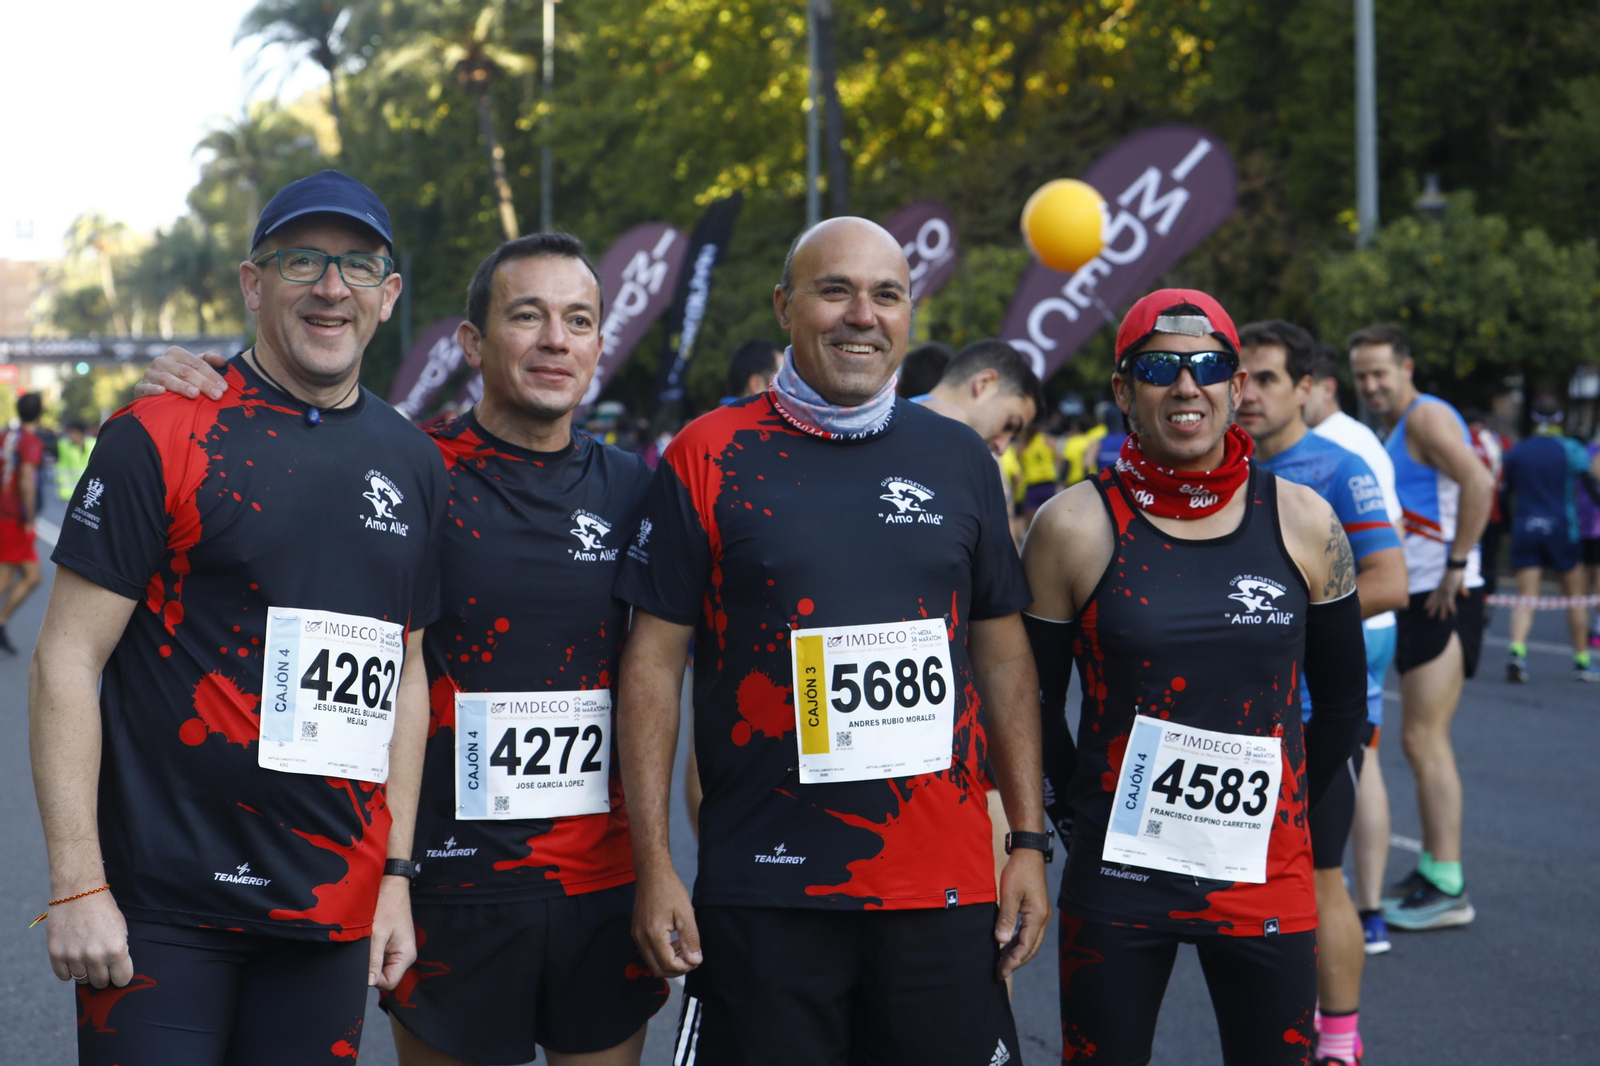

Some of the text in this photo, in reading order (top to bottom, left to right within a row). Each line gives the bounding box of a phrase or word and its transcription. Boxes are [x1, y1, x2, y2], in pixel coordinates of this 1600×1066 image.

[365, 469, 375, 481] CLUB
[381, 475, 404, 499] ATLETISMO
[881, 476, 893, 487] CLUB
[903, 479, 935, 496] ATLETISMO
[571, 508, 581, 520] CLUB
[586, 512, 612, 528] ATLETISMO
[1229, 575, 1243, 586] CLUB
[1253, 575, 1287, 591] ATLETISMO
[324, 621, 378, 641] IMDECO
[846, 630, 907, 647] IMDECO
[911, 635, 918, 643] 36
[274, 649, 291, 713] CAJÓN 4
[300, 648, 396, 712] 4262
[831, 655, 947, 713] 5686
[804, 666, 819, 727] CAJÓN 3
[313, 703, 388, 721] JESÚS RAFAEL BUJALANCE
[510, 700, 570, 714] IMDECO
[346, 716, 368, 727] MEJÍAS
[848, 713, 936, 728] ANDRES RUBIO MORALES
[490, 724, 603, 776] 4272
[1183, 734, 1242, 755] IMDECO
[465, 743, 479, 790] CAJÓN
[516, 779, 585, 789] JOSÉ GARCÍA LÓPEZ
[1125, 752, 1148, 810] CAJÓN 4
[1151, 758, 1270, 816] 4583
[1150, 807, 1262, 830] FRANCISCO ESPINO CARRETERO
[426, 847, 478, 858] TEAMERGY
[754, 854, 807, 865] TEAMERGY
[214, 872, 272, 887] TEAMERGY
[1100, 866, 1150, 882] TEAMERGY
